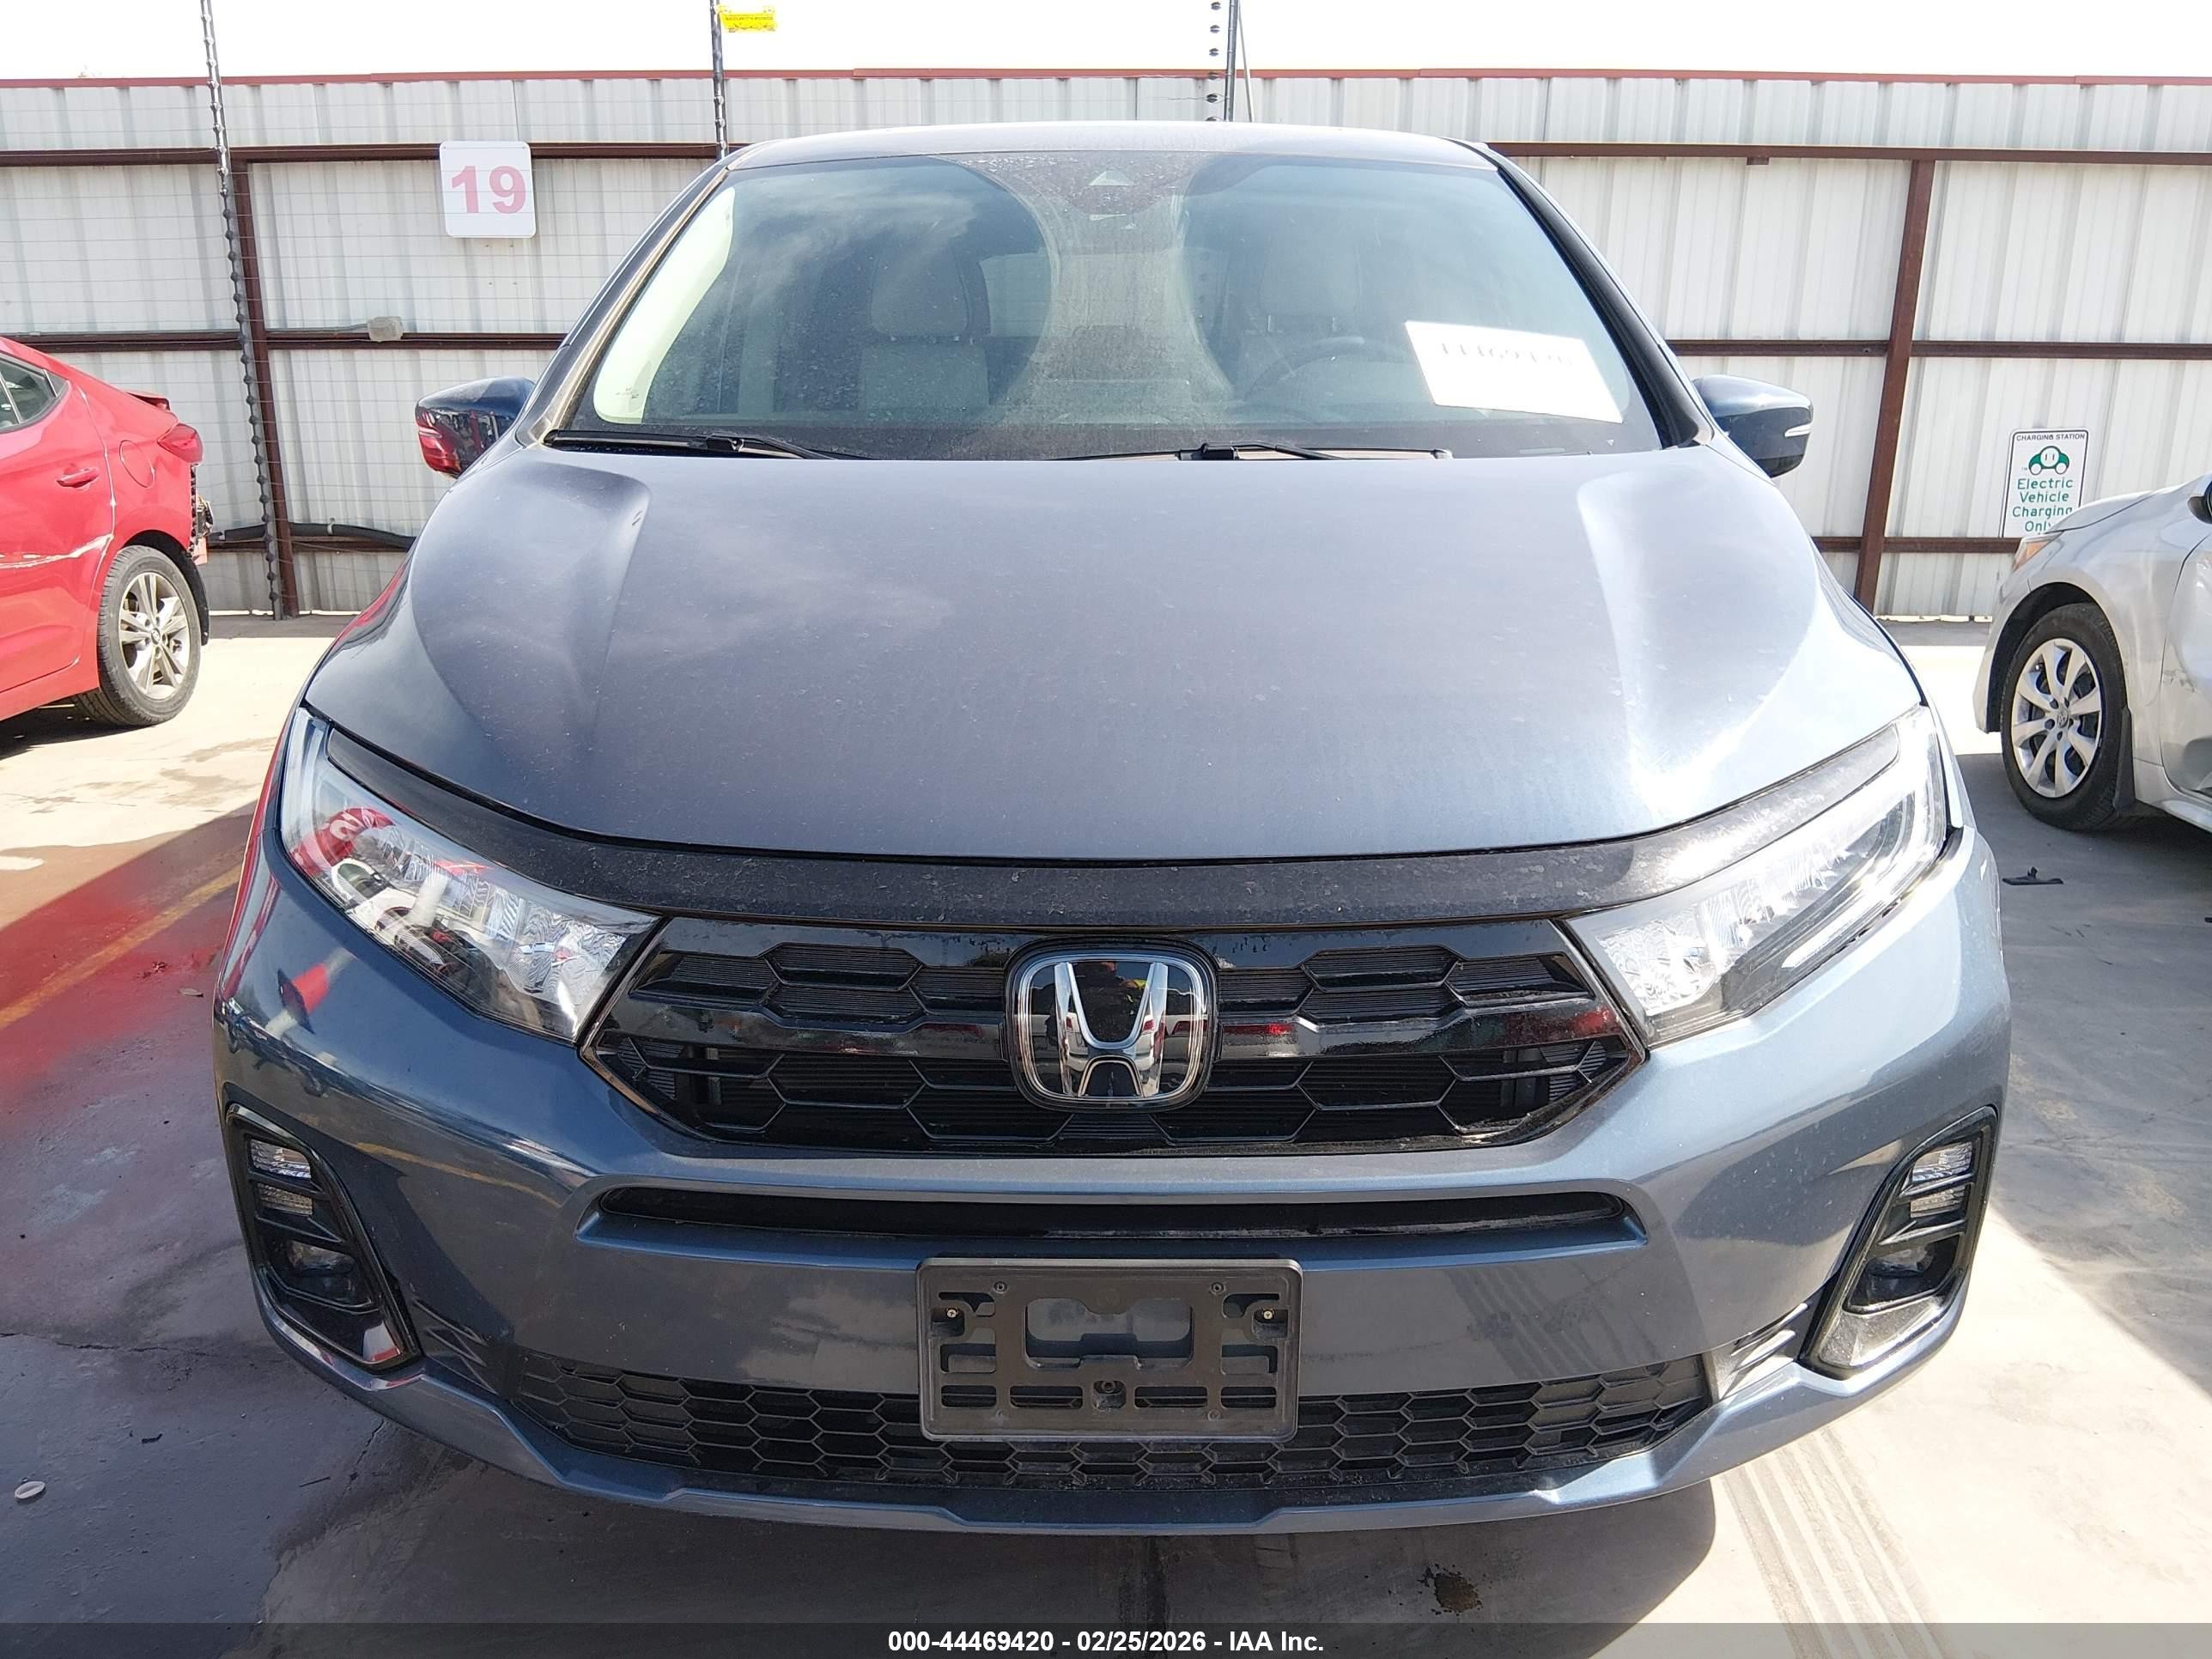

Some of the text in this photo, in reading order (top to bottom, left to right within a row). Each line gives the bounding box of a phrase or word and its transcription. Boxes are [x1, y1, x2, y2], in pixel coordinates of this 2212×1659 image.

[451, 165, 527, 215] 19
[2017, 477, 2074, 490] Electric
[2020, 491, 2069, 503] Vehicle
